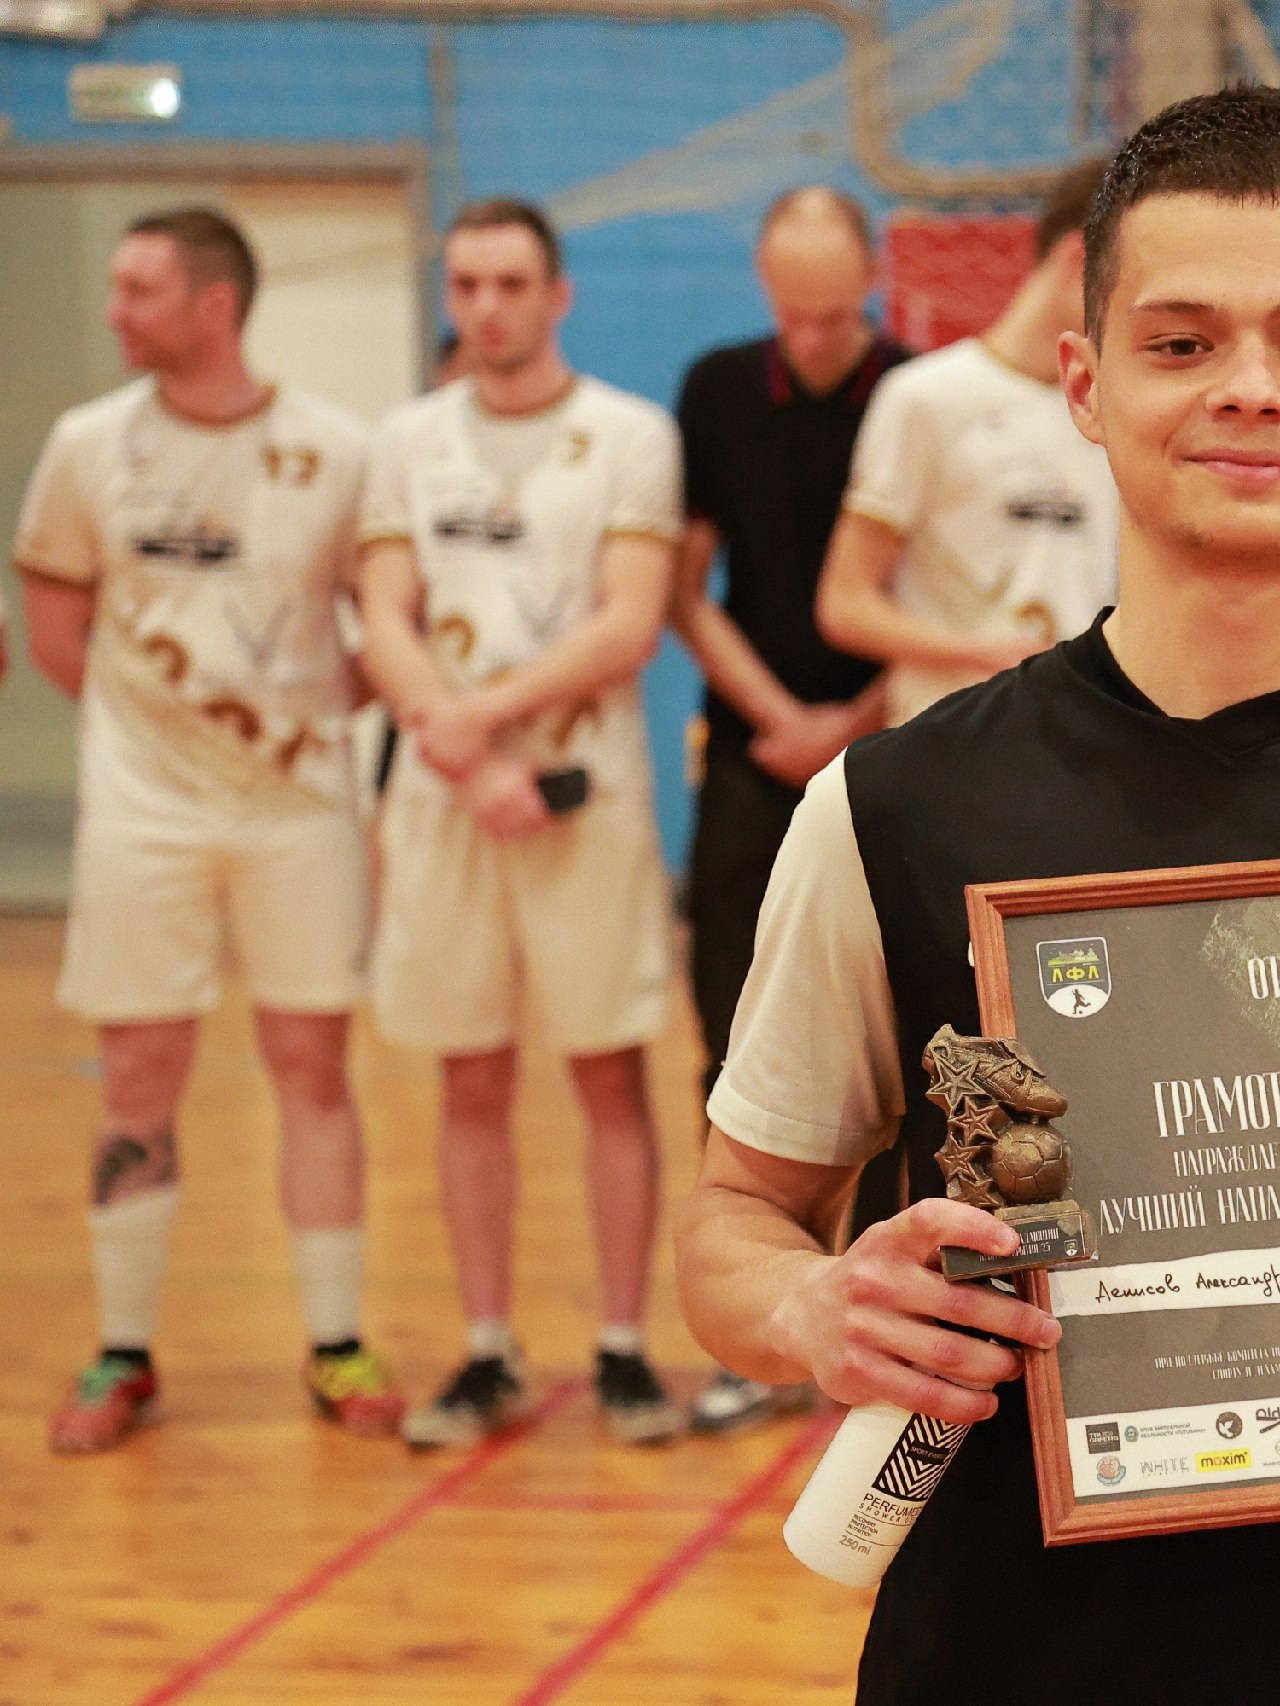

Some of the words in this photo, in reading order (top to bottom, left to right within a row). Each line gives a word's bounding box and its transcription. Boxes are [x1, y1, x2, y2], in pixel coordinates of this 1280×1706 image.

[1051, 966, 1100, 984] ЛФЛ
[1099, 1186, 1206, 1236] ЛУЧШИЙ
[1095, 1273, 1181, 1302] Денисов
[1201, 1453, 1247, 1468] maxim
[859, 1502, 901, 1522] SHOWER
